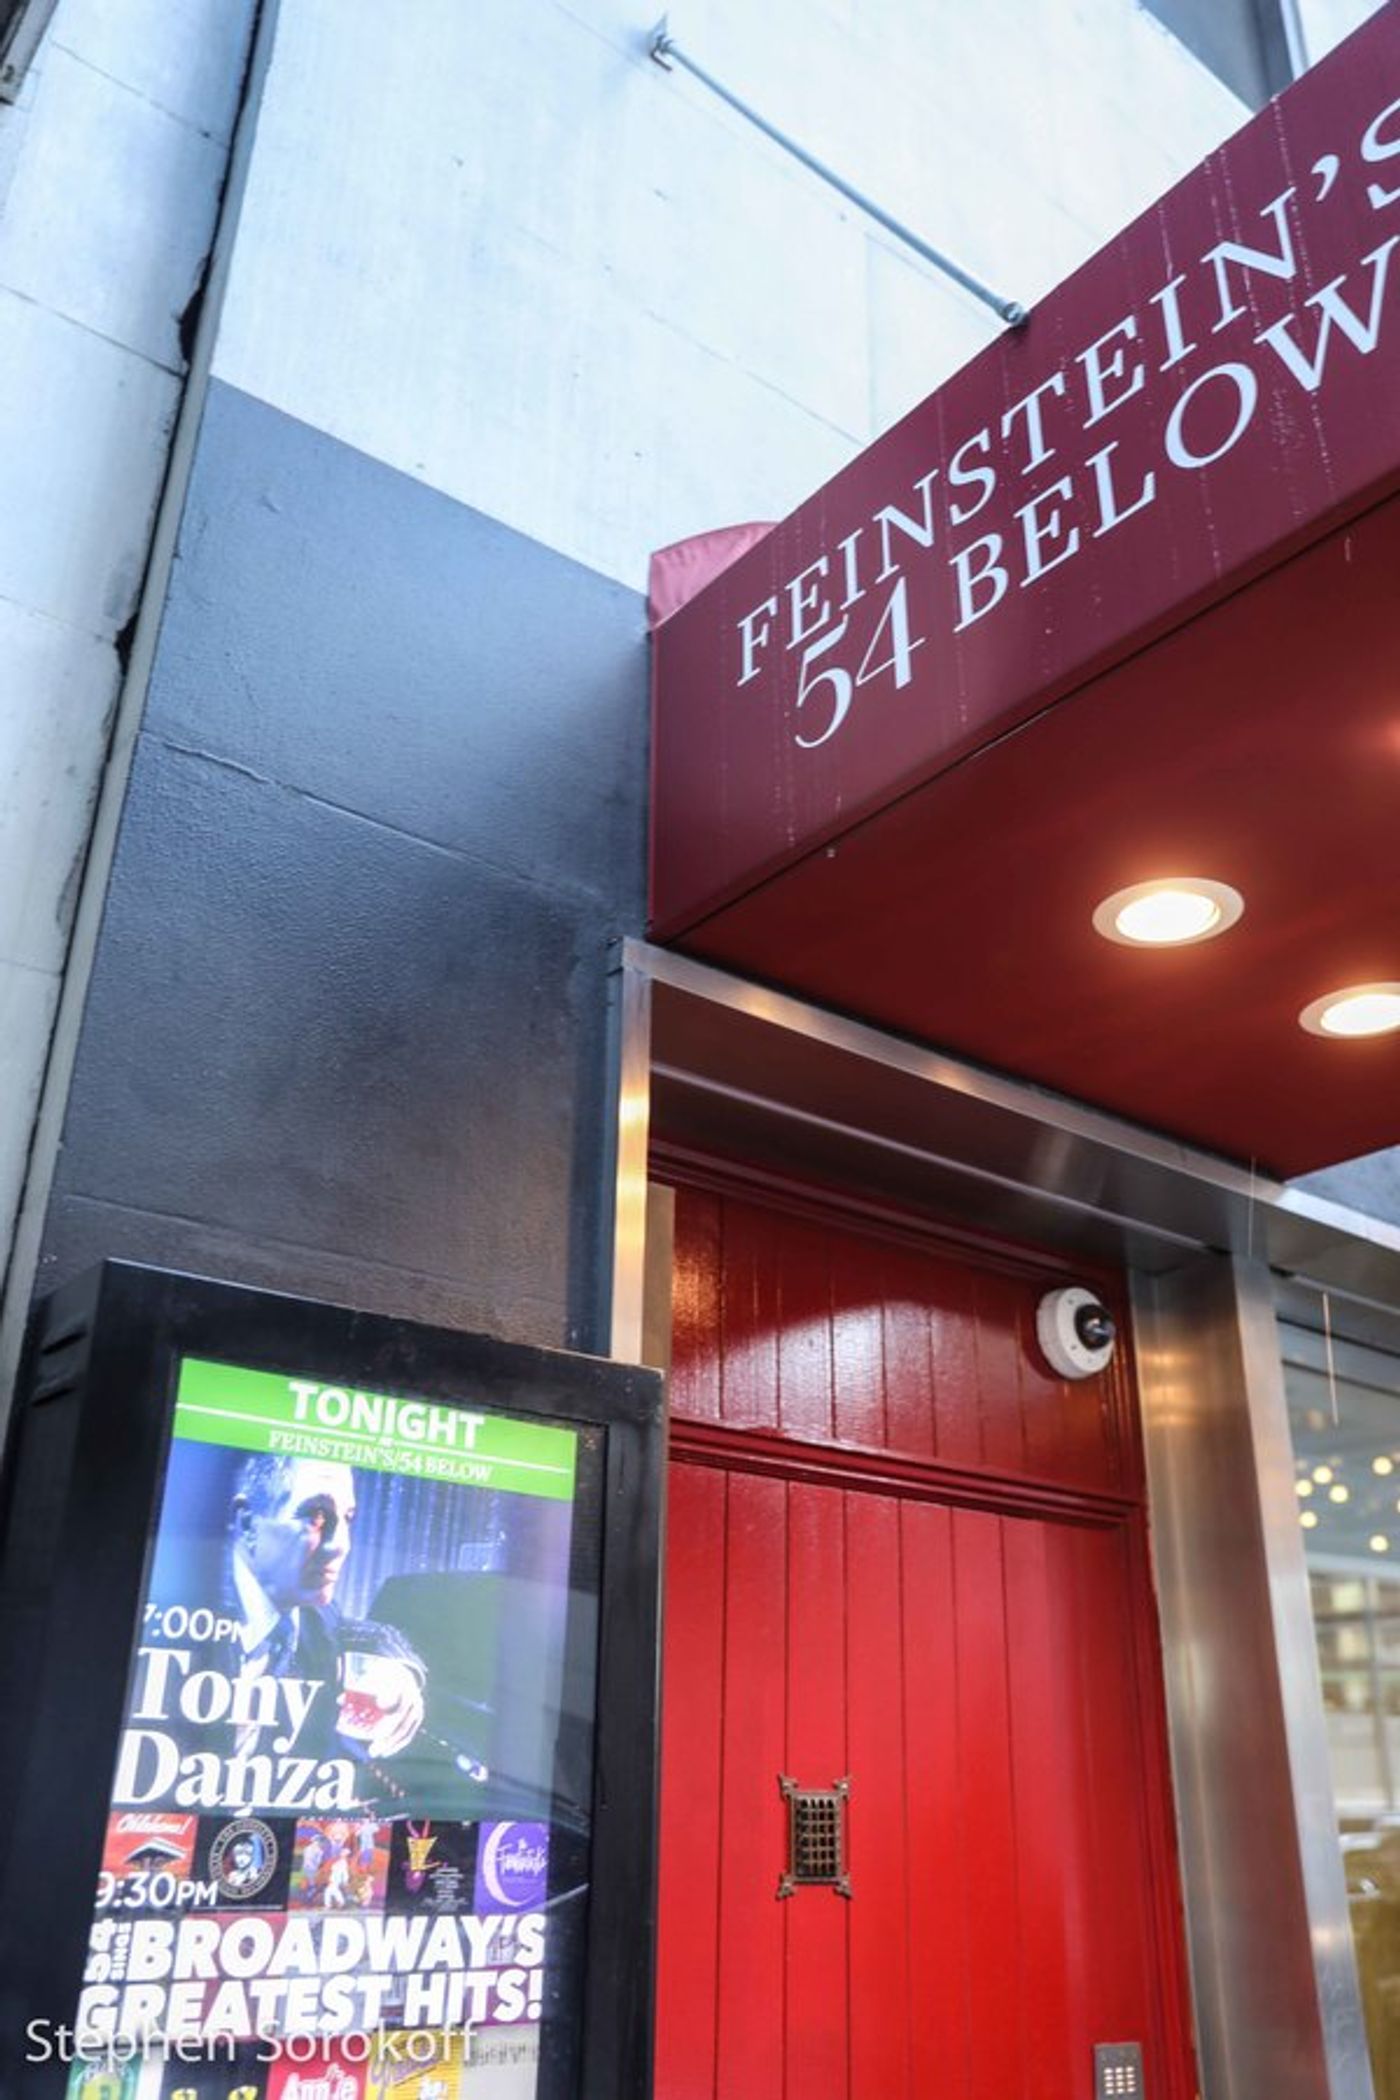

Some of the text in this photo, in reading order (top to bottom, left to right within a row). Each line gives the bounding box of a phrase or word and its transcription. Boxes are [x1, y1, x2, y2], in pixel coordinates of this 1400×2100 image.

[736, 97, 1400, 687] FEINSTEIN'S
[795, 236, 1400, 748] 54 BELOW
[289, 1381, 485, 1450] TONIGHT
[426, 1457, 493, 1482] BELOW
[133, 1647, 324, 1753] Tony
[111, 1730, 361, 1810] Danza
[94, 1871, 218, 1907] 9:30PM
[126, 1914, 547, 1981] BROADWAY'S
[74, 1968, 544, 2046] GREATEST HITS!
